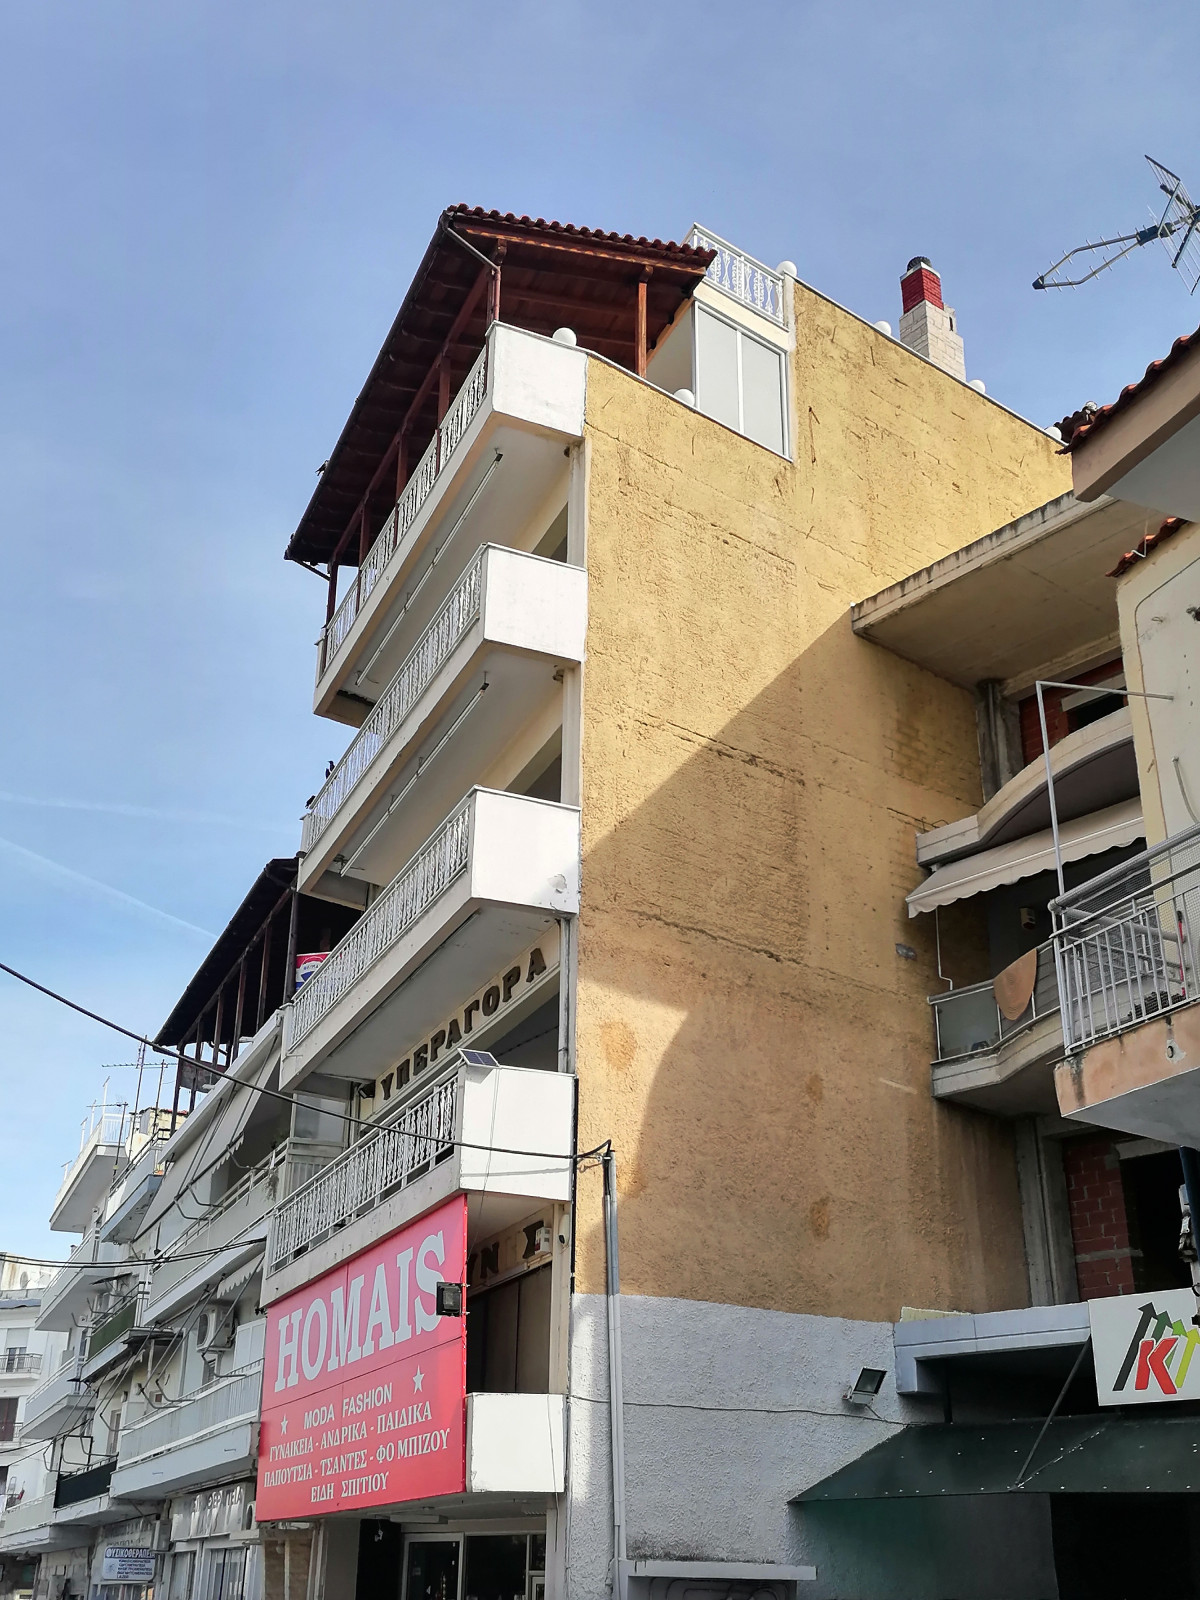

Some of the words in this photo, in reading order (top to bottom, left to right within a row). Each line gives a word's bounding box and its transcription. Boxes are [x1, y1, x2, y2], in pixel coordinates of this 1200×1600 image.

[381, 948, 547, 1101] ΥΠΕΡΑΓΟΡΑ
[274, 1230, 445, 1393] HOMAIS
[269, 1436, 314, 1462] ΓΥΝΑΙΚΕΙΑ
[320, 1420, 368, 1450] ΑΝΔΡΙΚΑ
[377, 1400, 432, 1435] ΠΑΙΔΙΚΑ
[303, 1403, 335, 1430] MODA
[342, 1382, 393, 1418] FASHION
[263, 1462, 313, 1488] ΠΑΠΟΥΤΣΙΑ
[320, 1449, 368, 1477] ΤΣΑΝΤΕΣ
[310, 1482, 335, 1503] ΕΙΔΗ
[341, 1471, 390, 1498] ΣΠΙΤΙΟΥ
